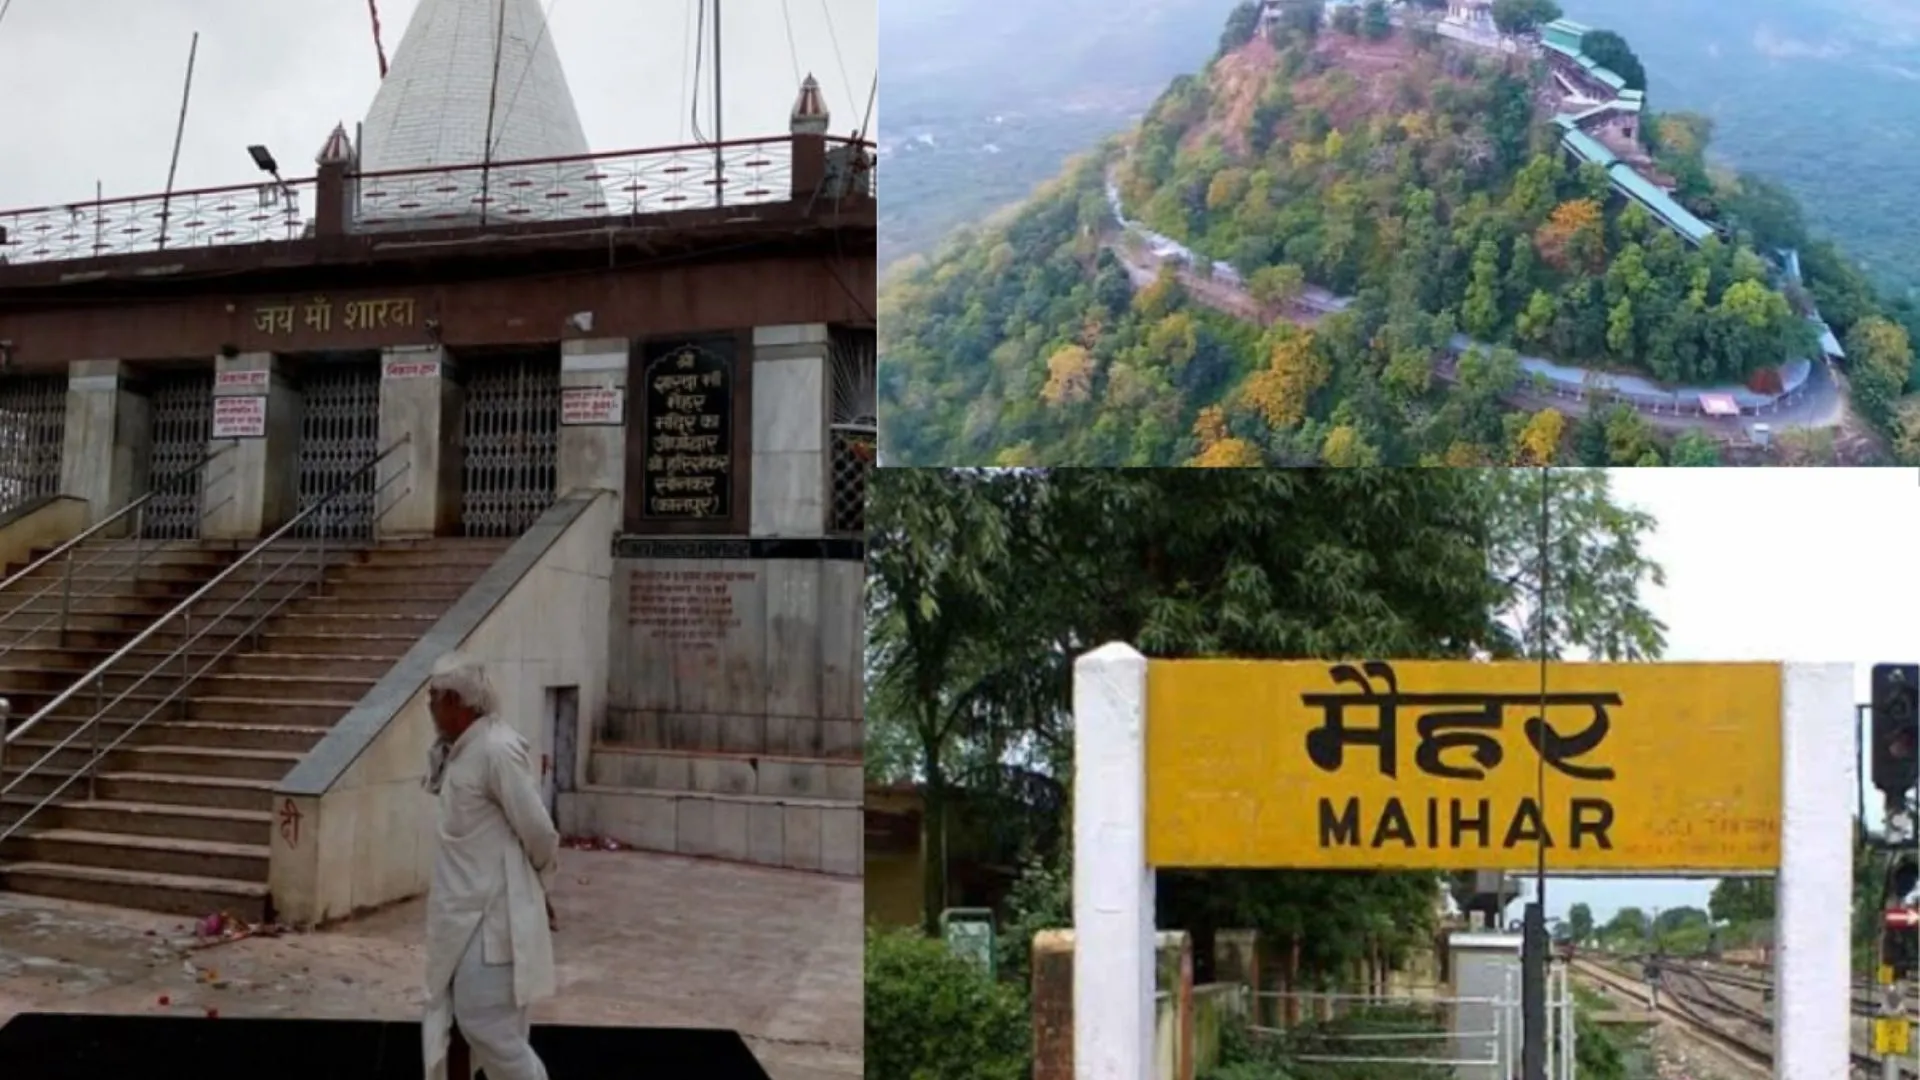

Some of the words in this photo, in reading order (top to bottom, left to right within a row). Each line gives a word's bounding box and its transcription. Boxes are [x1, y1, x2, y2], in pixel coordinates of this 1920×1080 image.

[254, 307, 293, 334] जय
[304, 297, 331, 332] माँ
[344, 298, 415, 330] शारदा
[1301, 662, 1622, 780] मैहर
[1319, 797, 1615, 850] MAIHAR
